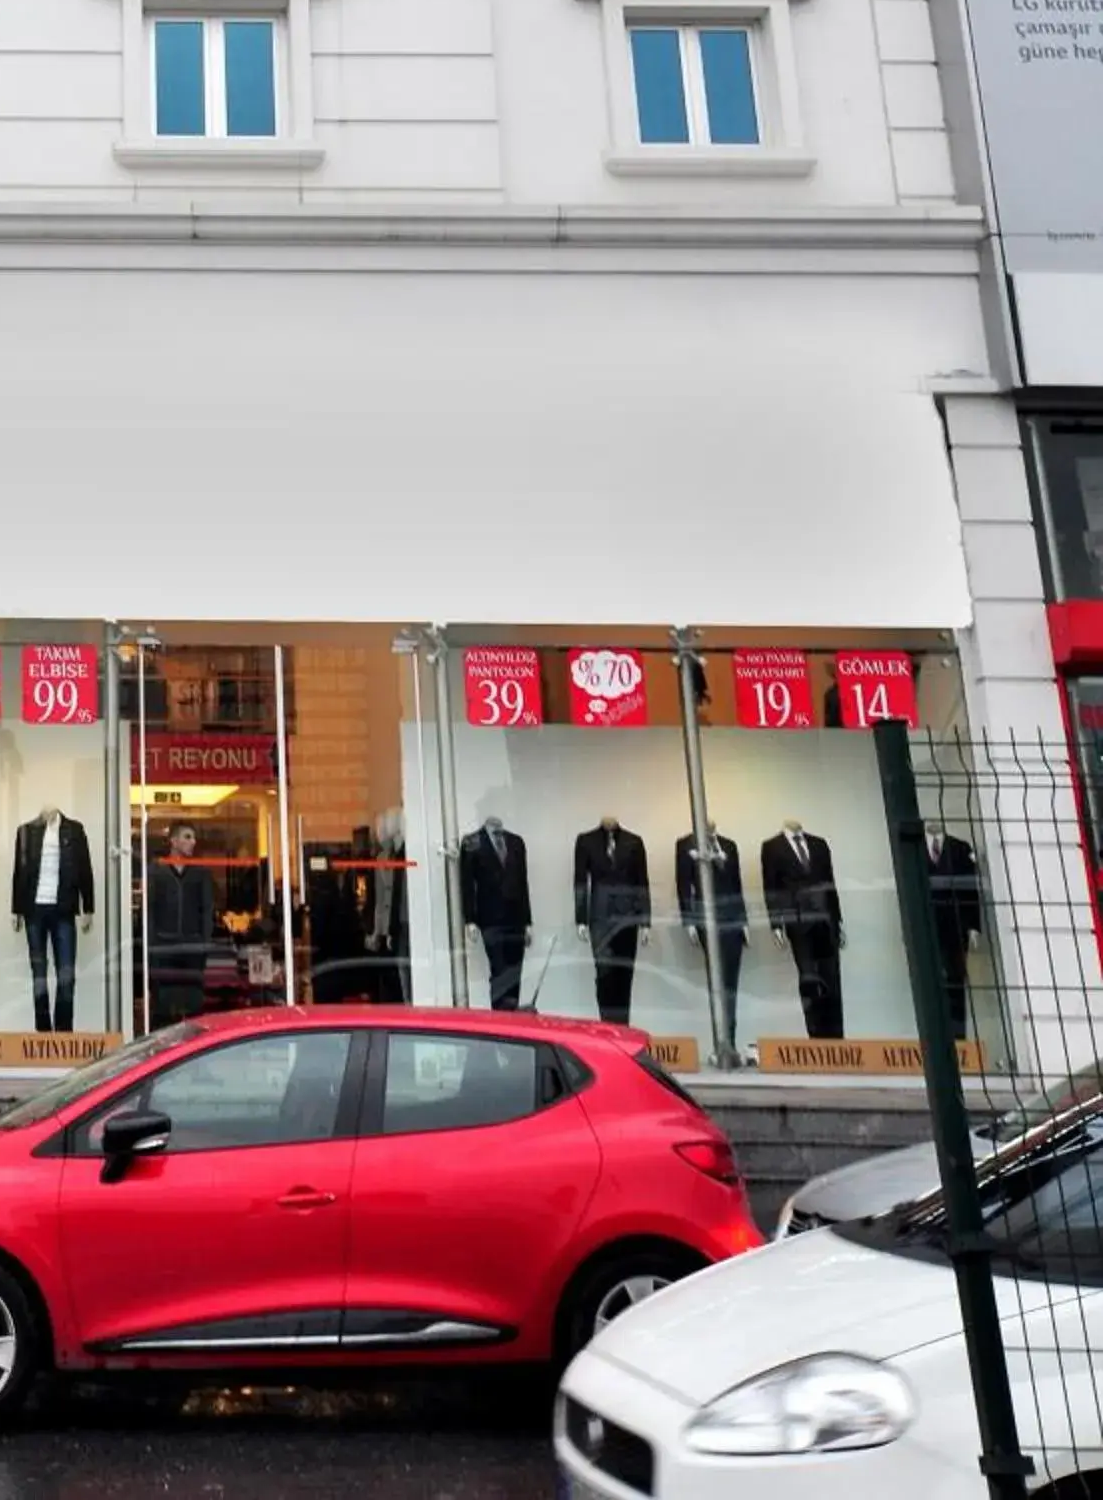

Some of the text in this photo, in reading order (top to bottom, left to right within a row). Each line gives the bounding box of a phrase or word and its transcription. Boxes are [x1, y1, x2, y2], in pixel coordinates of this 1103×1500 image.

[838, 656, 910, 677] GÖMLEK
[33, 679, 79, 723] 99
[477, 679, 524, 726] 39
[752, 681, 793, 728] 19
[850, 682, 893, 729] 14
[167, 746, 257, 771] REYONU
[21, 1038, 106, 1061] ALTINYILDIZ
[777, 1044, 864, 1068] ALTINYILDIZ
